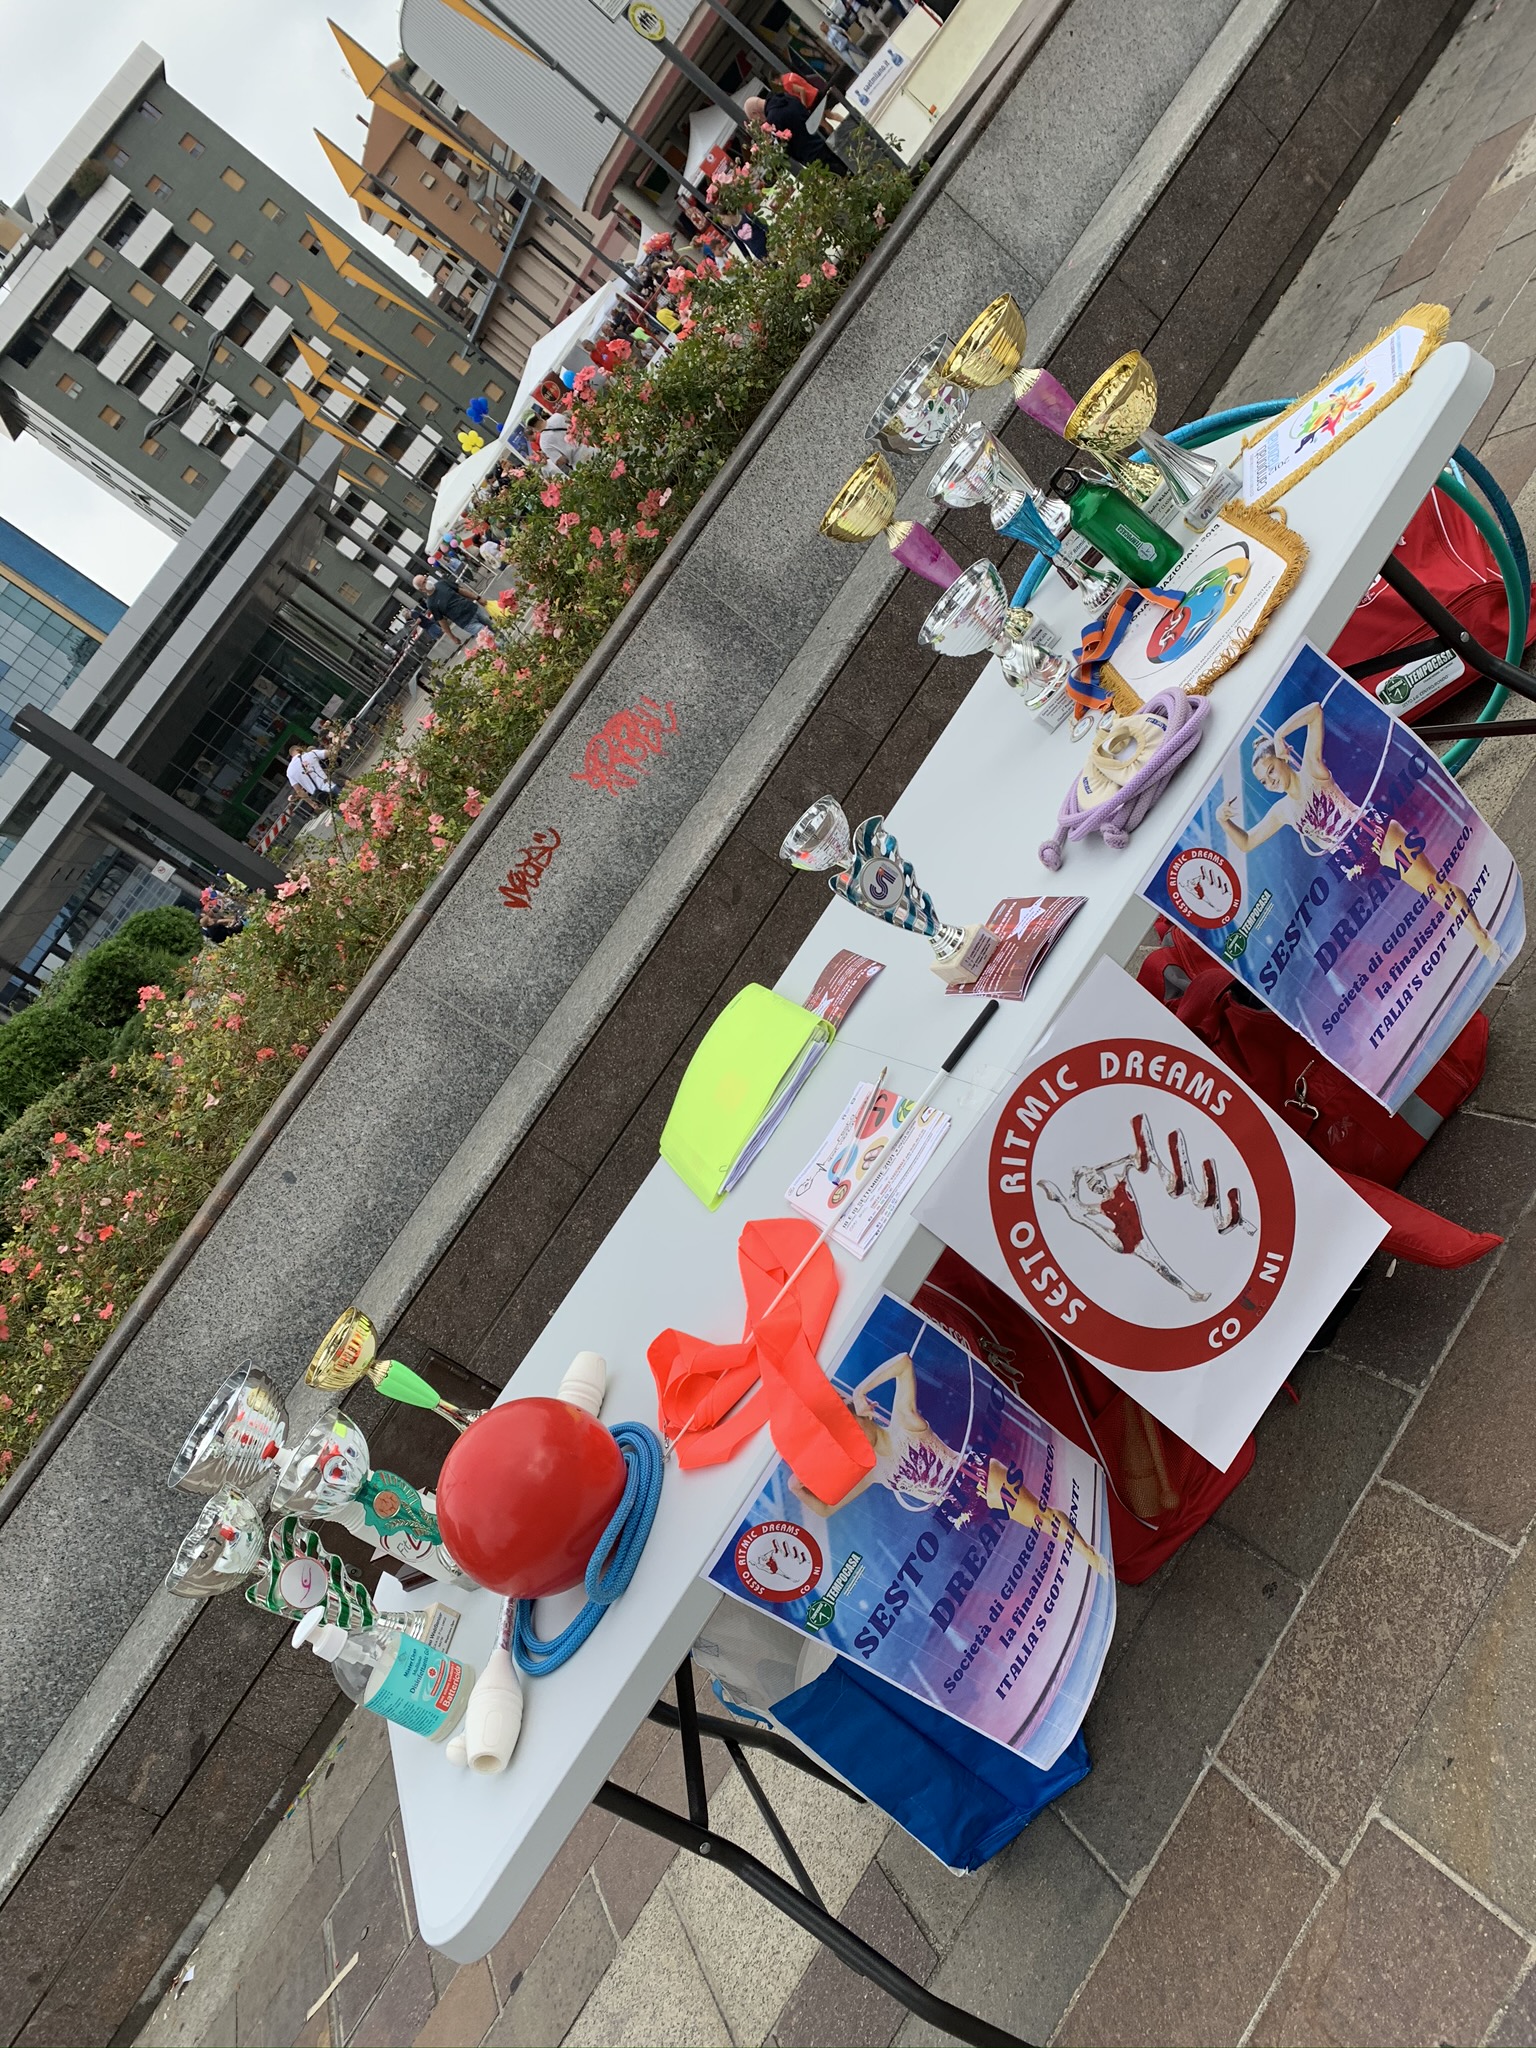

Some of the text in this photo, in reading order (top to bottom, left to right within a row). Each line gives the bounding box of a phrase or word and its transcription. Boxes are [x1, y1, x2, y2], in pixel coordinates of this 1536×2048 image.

[862, 59, 890, 92] saetmilano.it
[1072, 538, 1086, 553] Ritmic
[1116, 525, 1141, 547] TEMPOCASA
[1200, 522, 1220, 542] 2013
[1408, 649, 1453, 685] TEMPOCASA
[1169, 848, 1224, 918] SESTO RITMIC DREAMS
[1256, 748, 1434, 995] SESTO RITMIC
[1313, 826, 1429, 975] DREAMS
[1220, 897, 1240, 924] CO NI
[1239, 889, 1272, 934] TEMPOCASA
[1318, 824, 1476, 1035] Società di GIORGIA GRECO,
[1373, 887, 1459, 1001] la finalista di
[1366, 863, 1495, 1050] ITALIA'S GOT TALENT!
[857, 1171, 884, 1207] SETTEMBRE
[883, 1153, 895, 1170] 2021
[997, 1050, 1232, 1327] SESTO RITMIC DREAMS
[1206, 1249, 1285, 1347] CO NI
[853, 1528, 944, 1660] SESTO
[931, 1382, 1014, 1536] RITMIC
[929, 1459, 1030, 1633] DREAMS
[736, 1522, 800, 1595] SESTO RITMIC DREAMS
[825, 1551, 861, 1602] TEMPOCASA
[941, 1444, 1061, 1695] Società di GIORGIA GRECO,
[994, 1478, 1085, 1701] ITALIA'S GOT TALENT!
[998, 1512, 1065, 1650] la finalista di
[409, 1657, 429, 1694] Disinfettante
[442, 1665, 461, 1708] Battericida
